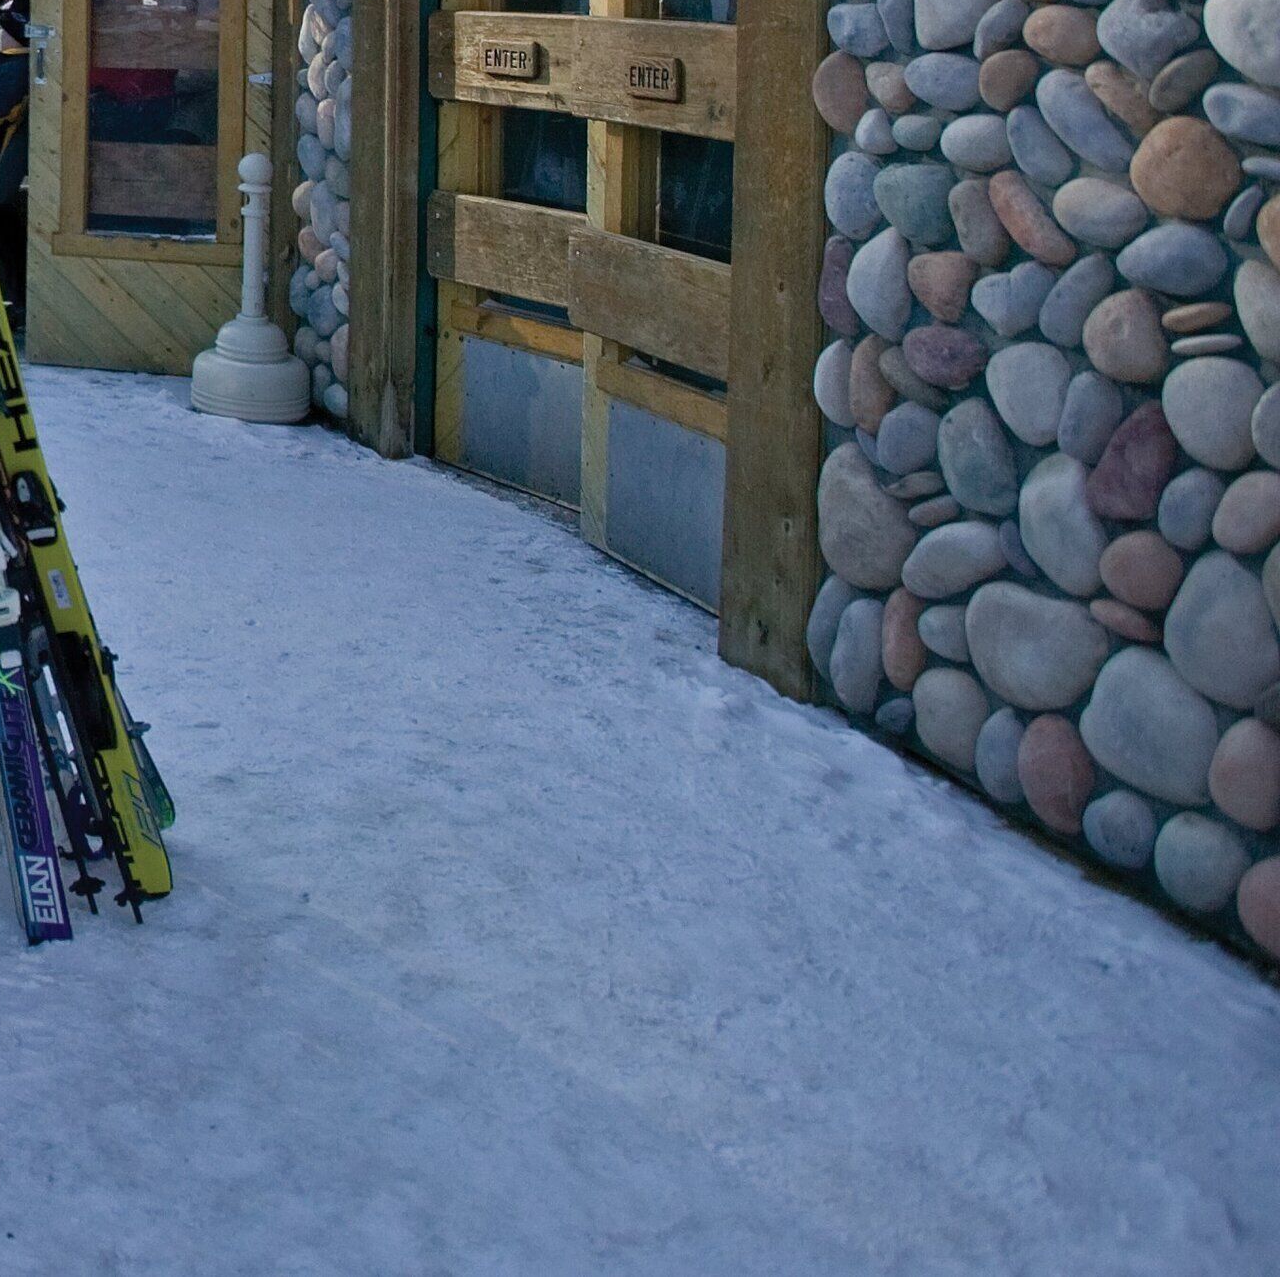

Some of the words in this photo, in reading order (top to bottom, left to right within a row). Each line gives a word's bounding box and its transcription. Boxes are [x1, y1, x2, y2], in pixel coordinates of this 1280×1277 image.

[484, 48, 528, 70] ENTER
[629, 65, 670, 90] ENTER
[25, 855, 57, 923] ELAN
